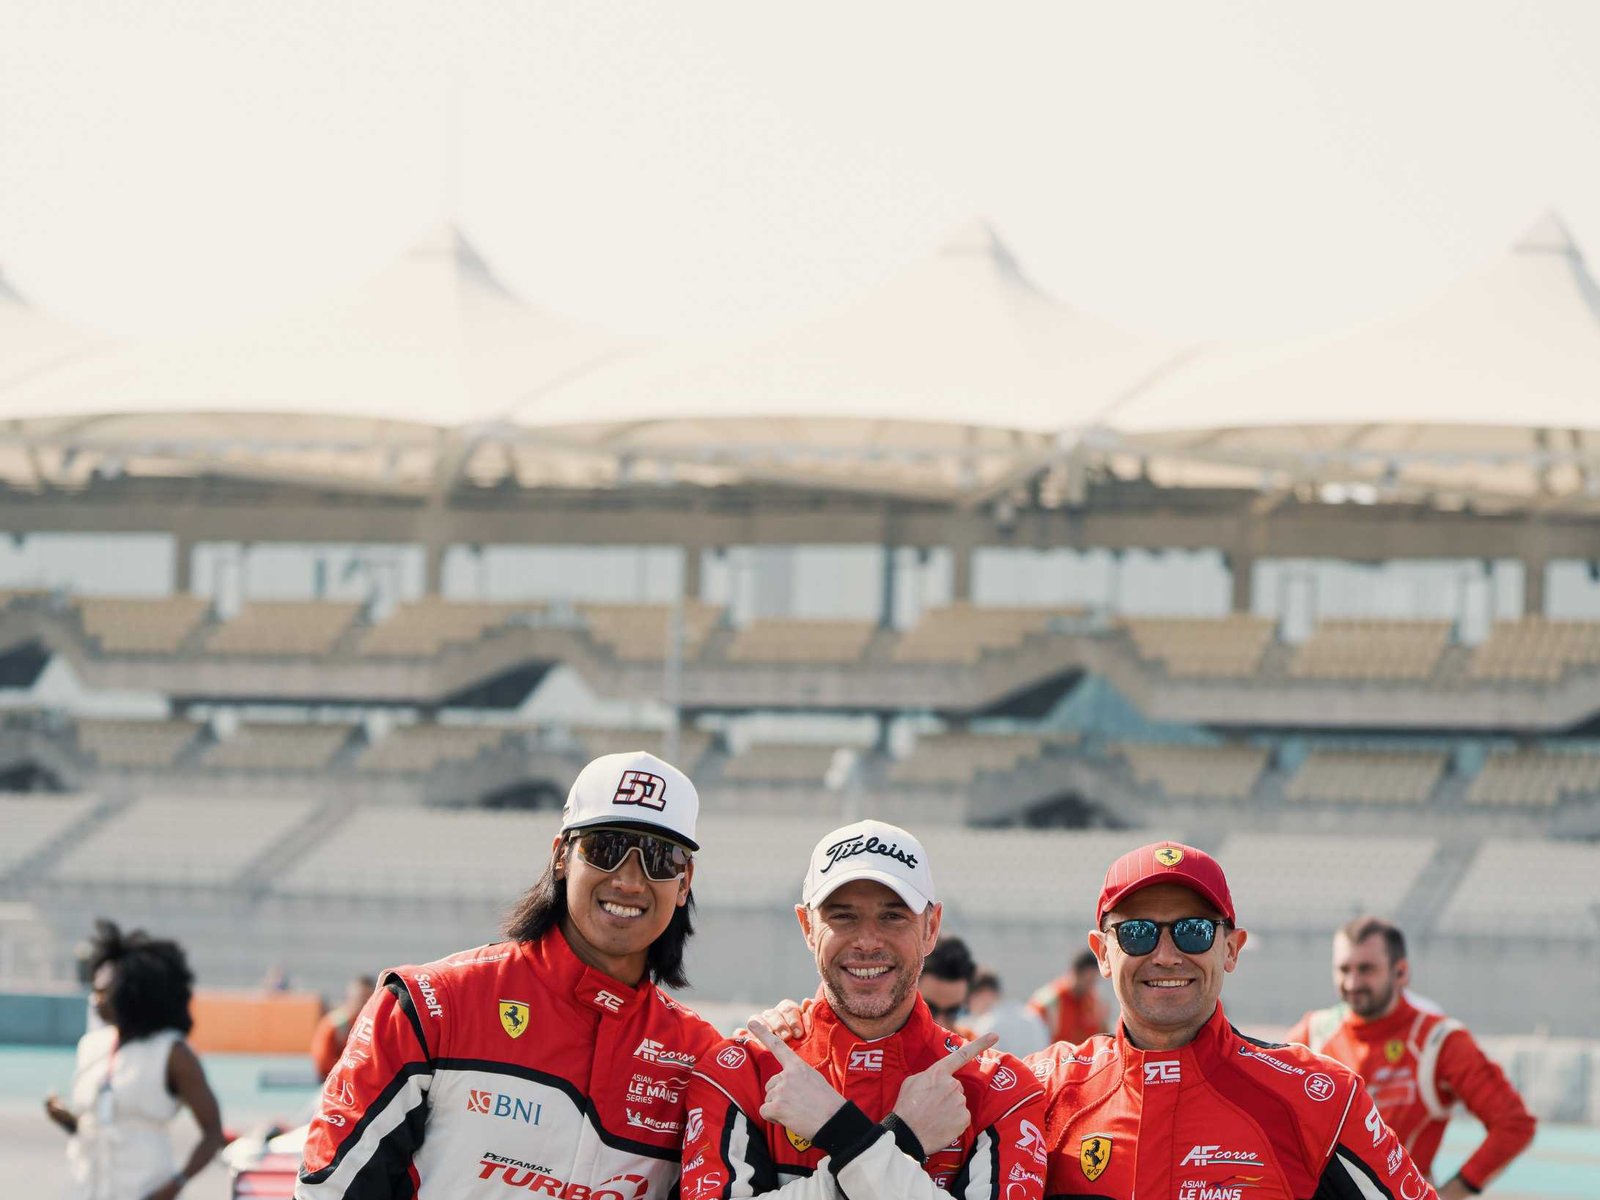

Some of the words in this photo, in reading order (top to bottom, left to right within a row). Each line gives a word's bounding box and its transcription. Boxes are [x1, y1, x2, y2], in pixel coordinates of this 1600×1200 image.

[612, 770, 666, 811] 51
[820, 834, 918, 873] Titleist
[414, 973, 442, 1018] Sabelt
[1254, 1051, 1306, 1075] MICHELIN
[632, 1073, 653, 1085] ASIAN
[993, 1070, 1012, 1086] 21
[1310, 1079, 1329, 1095] 21
[626, 1093, 653, 1105] SERIES
[628, 1081, 644, 1095] LE
[646, 1085, 679, 1104] MANS
[494, 1094, 543, 1126] BNI
[644, 1116, 684, 1130] MICHEL
[483, 1151, 553, 1174] PERTAMAX
[1181, 1180, 1206, 1189] ASIAN
[1178, 1189, 1196, 1200] LE
[1199, 1189, 1242, 1200] MANS
